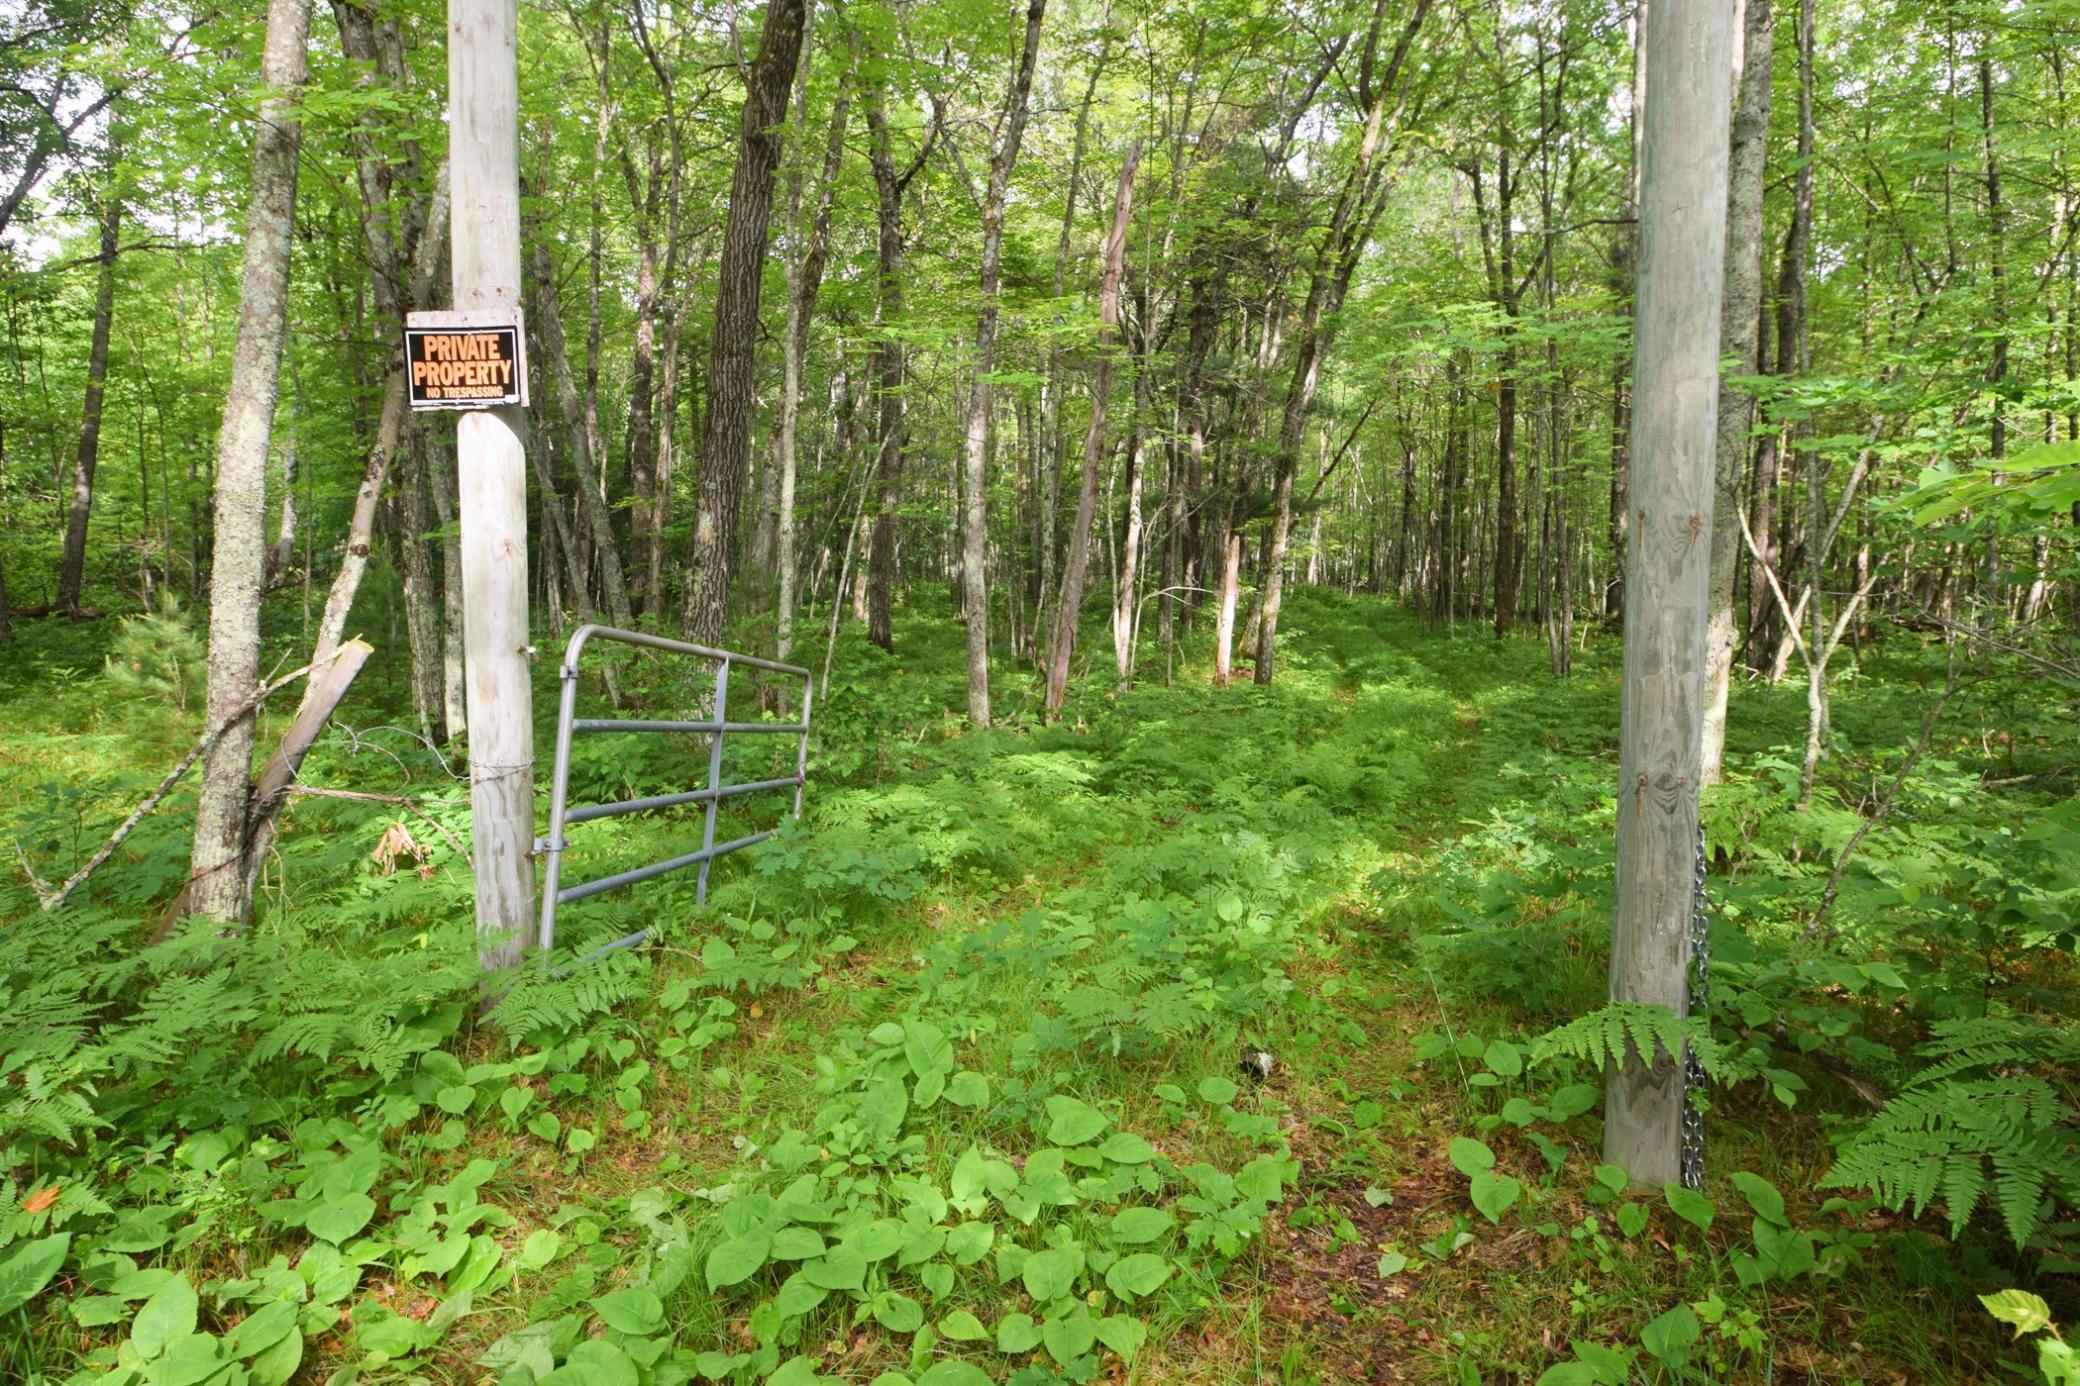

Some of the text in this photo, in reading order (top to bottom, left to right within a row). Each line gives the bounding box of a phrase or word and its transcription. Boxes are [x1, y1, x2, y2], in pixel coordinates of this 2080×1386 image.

[423, 333, 501, 361] PRIVATE
[412, 359, 512, 386] PROPERTY
[426, 386, 503, 399] NO TRESPASSING
